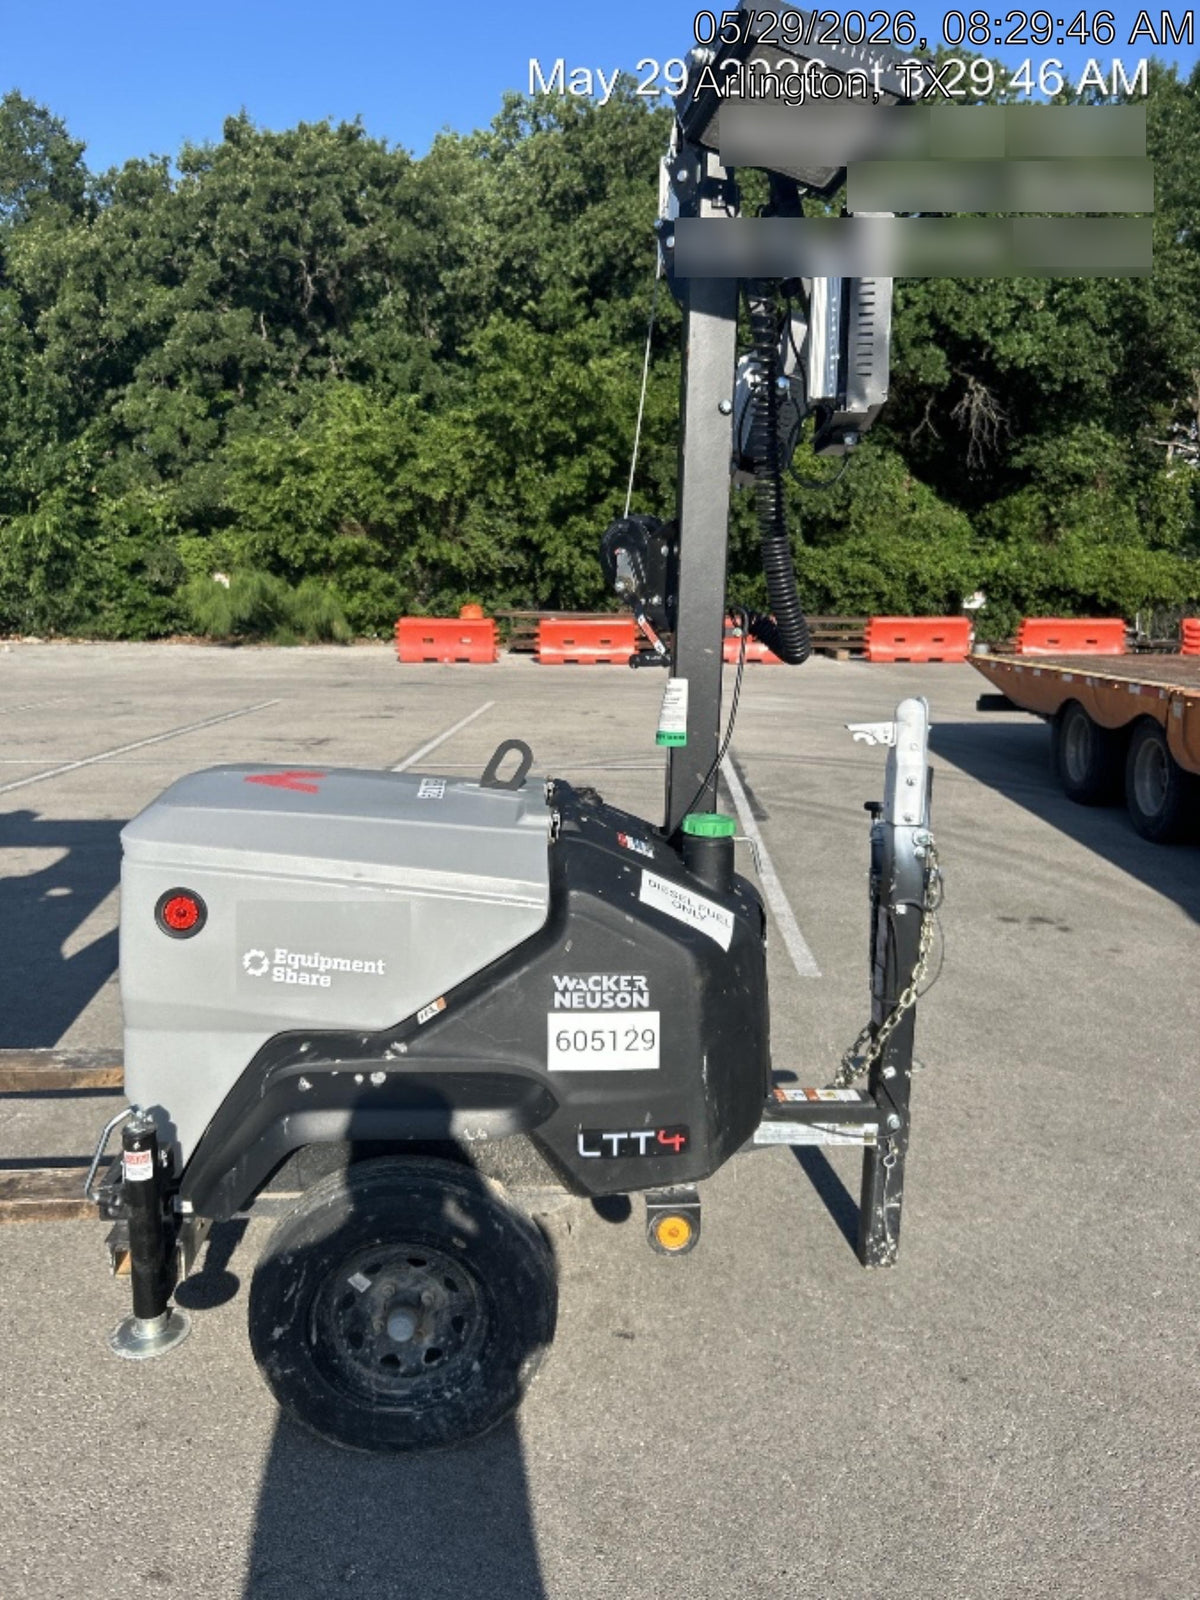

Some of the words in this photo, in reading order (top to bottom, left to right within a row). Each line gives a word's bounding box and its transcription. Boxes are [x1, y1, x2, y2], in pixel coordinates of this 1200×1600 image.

[648, 879, 694, 908] DIESEL
[698, 904, 731, 929] FUEL
[671, 900, 707, 921] ONLY
[273, 948, 386, 975] Equipment
[272, 967, 331, 987] Share
[552, 975, 649, 991] WACKER
[554, 992, 650, 1008] NEUSON
[556, 1028, 655, 1052] 605129
[577, 1130, 685, 1157] LTT4
